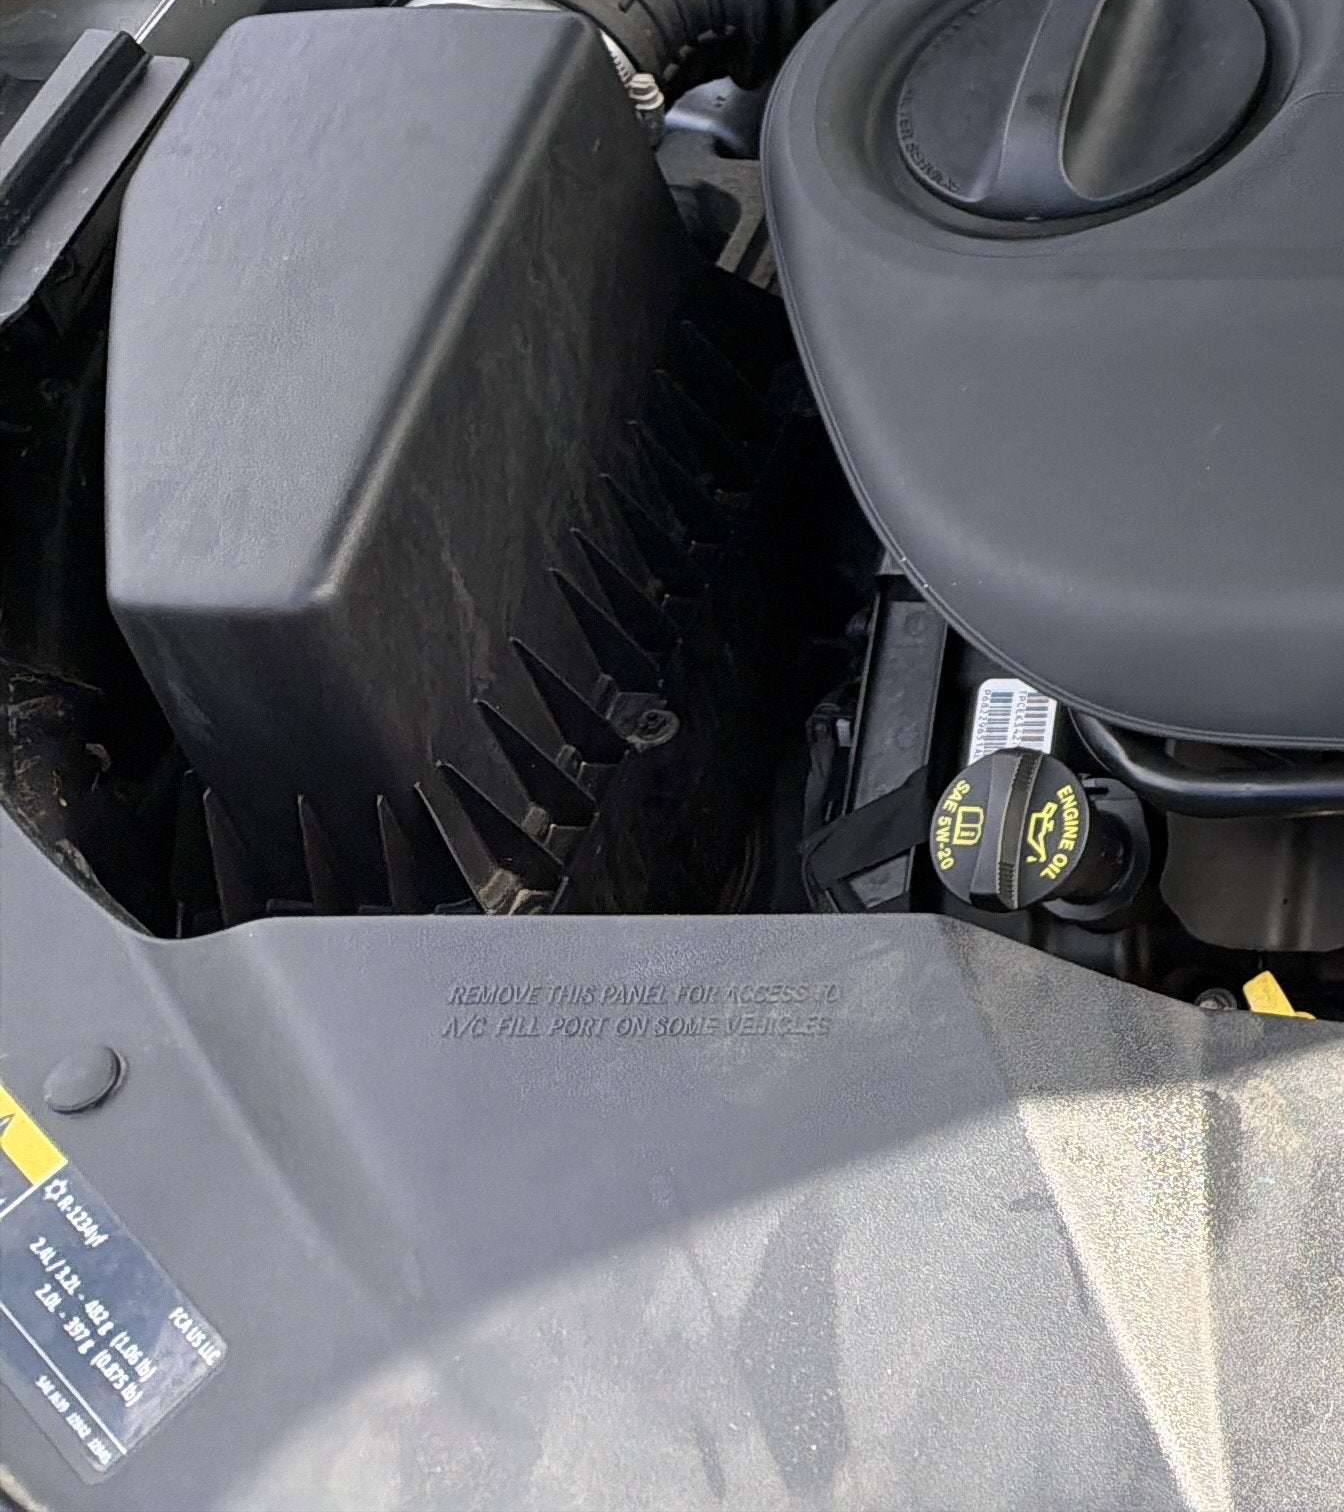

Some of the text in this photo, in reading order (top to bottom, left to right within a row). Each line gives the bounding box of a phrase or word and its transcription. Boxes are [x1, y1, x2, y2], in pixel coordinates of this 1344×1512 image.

[934, 778, 971, 872] SAE 5W-20
[1039, 784, 1080, 881] ENGINE OIL
[447, 984, 541, 1004] REMOVE
[544, 984, 596, 1004] THIS
[599, 984, 669, 1004] PANEL
[674, 984, 718, 1004] FOR
[441, 1015, 487, 1039] A/C
[494, 1014, 542, 1037] FILL
[547, 1015, 608, 1037] PORT
[614, 1015, 649, 1037] ON
[653, 1015, 720, 1037] SOME
[57, 1195, 109, 1248] R-1234yf
[63, 1316, 91, 1345] 397
[168, 1306, 223, 1367] FCA US LLC
